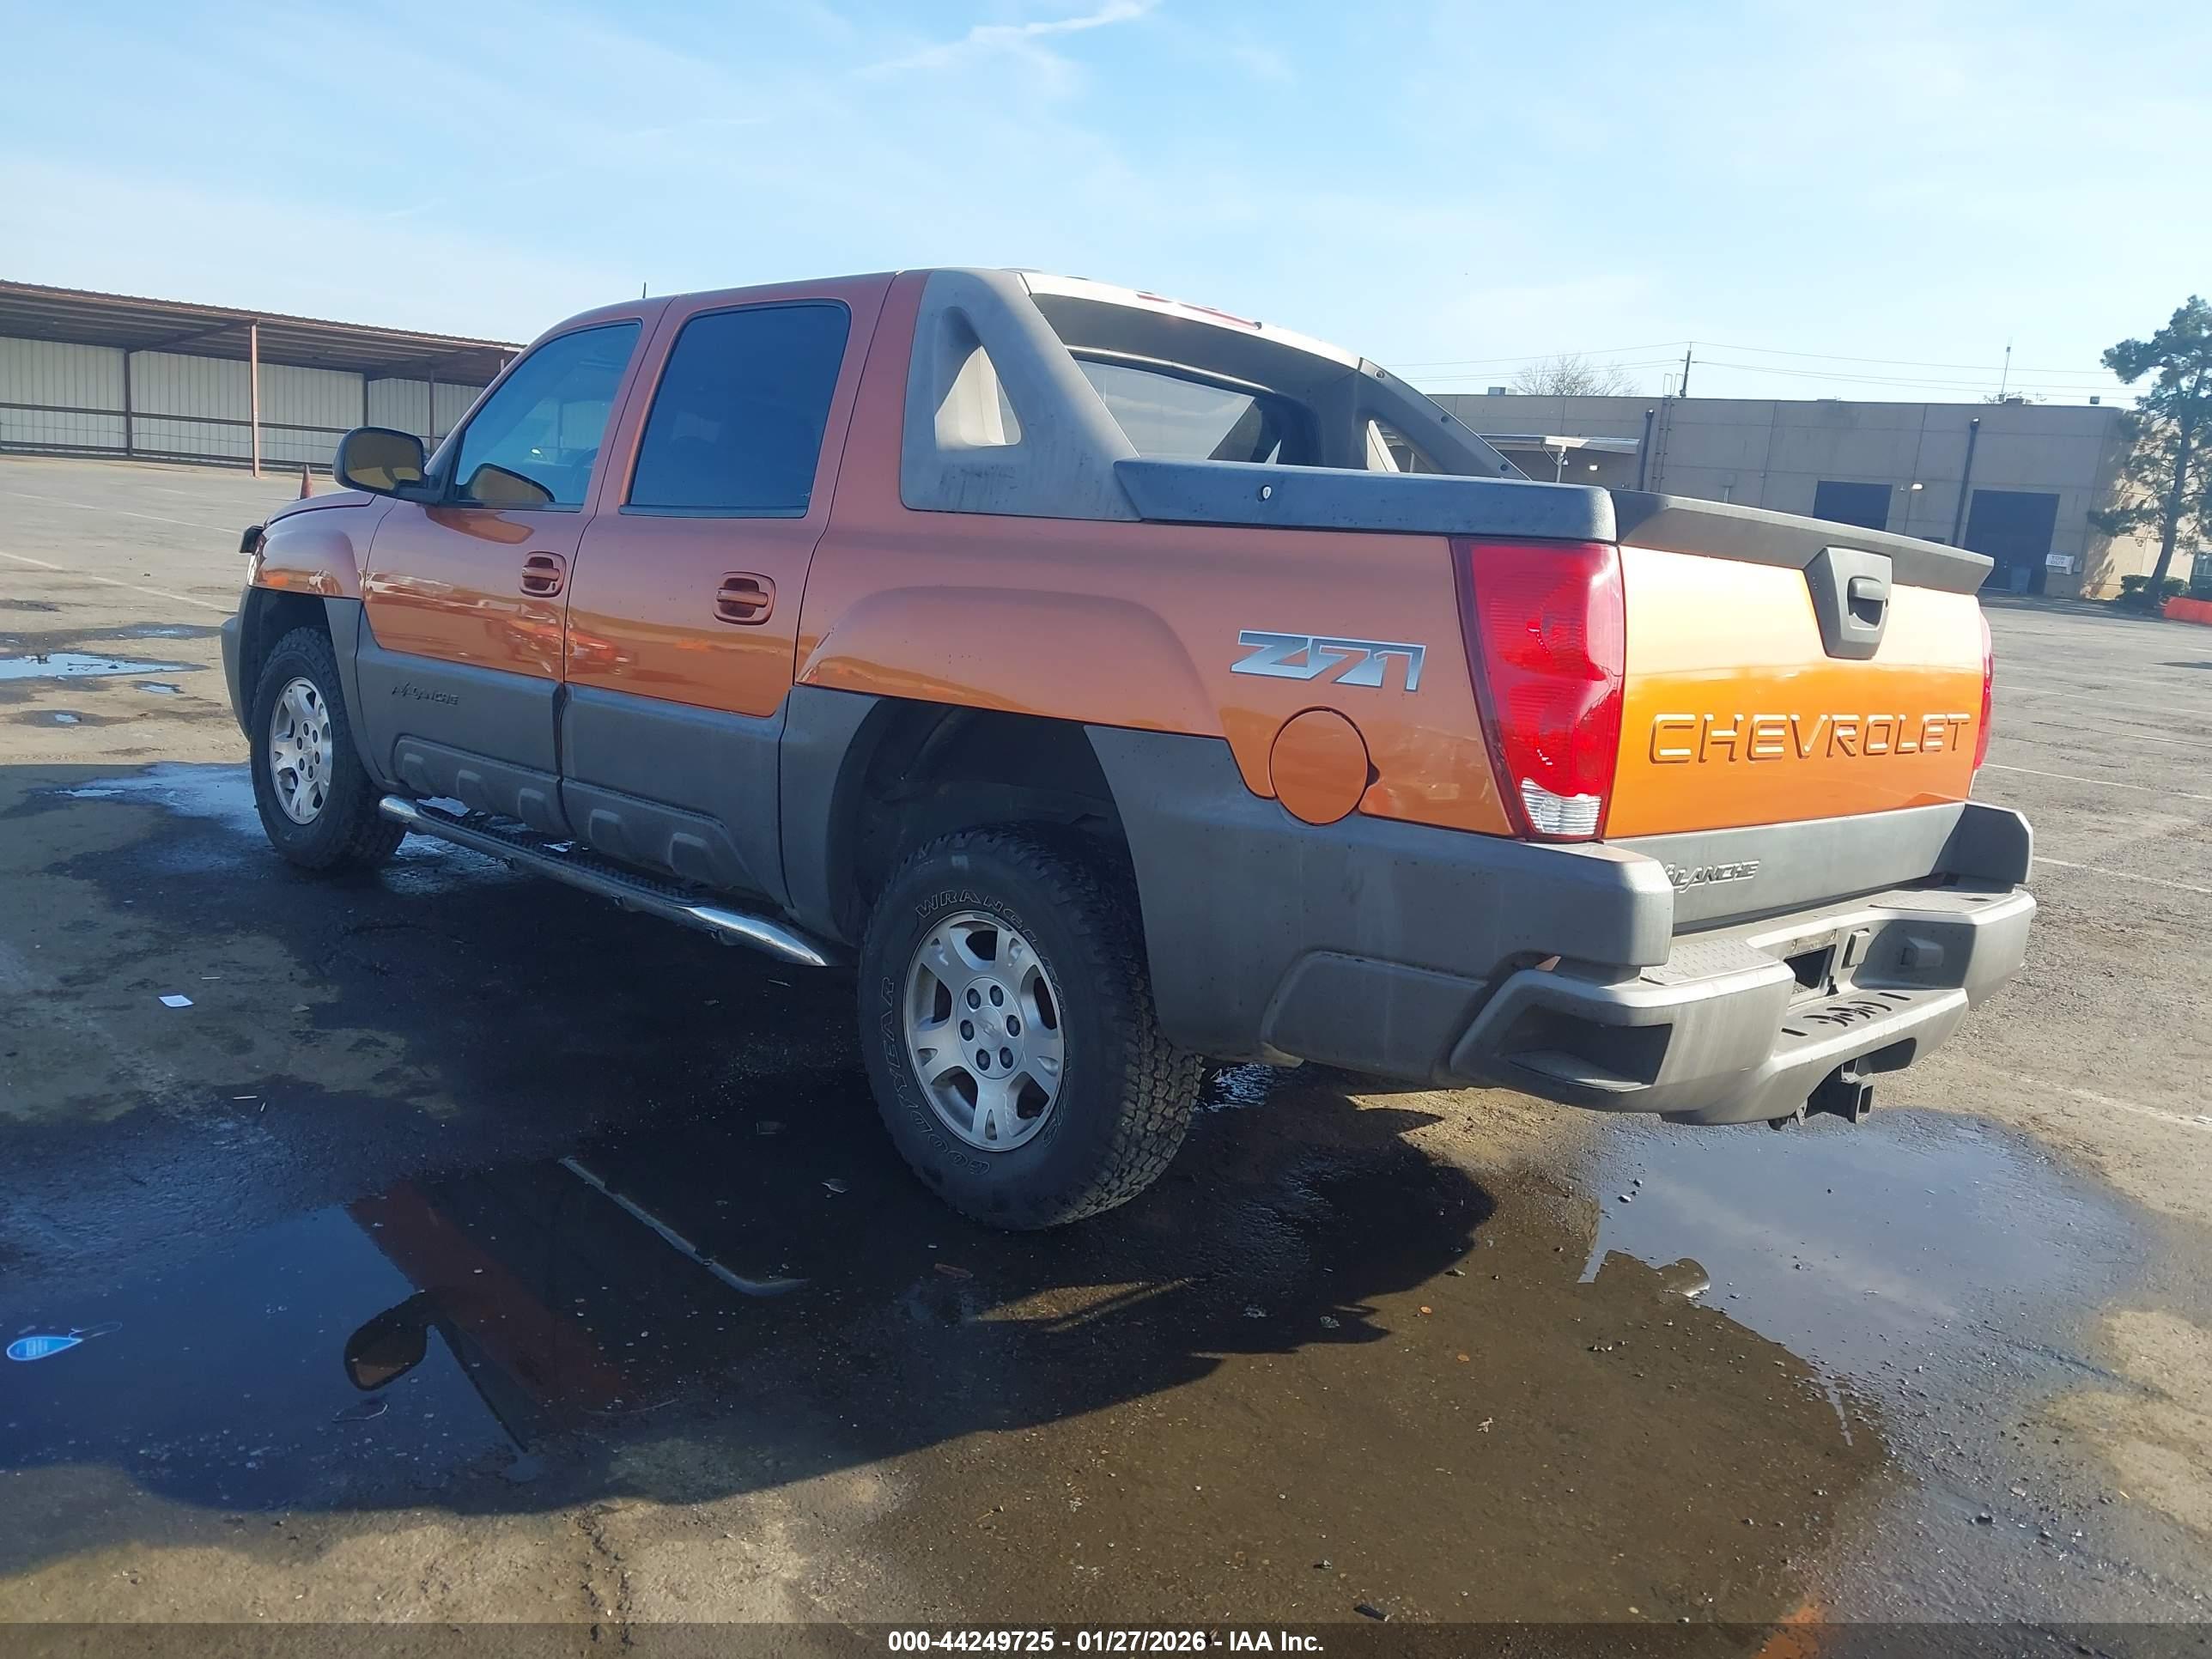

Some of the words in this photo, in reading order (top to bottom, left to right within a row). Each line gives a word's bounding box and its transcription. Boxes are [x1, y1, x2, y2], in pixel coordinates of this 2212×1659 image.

[1230, 629, 1426, 692] Z71
[1649, 714, 1972, 765] CHEVROLET
[878, 976, 991, 1176] GOODYEAR
